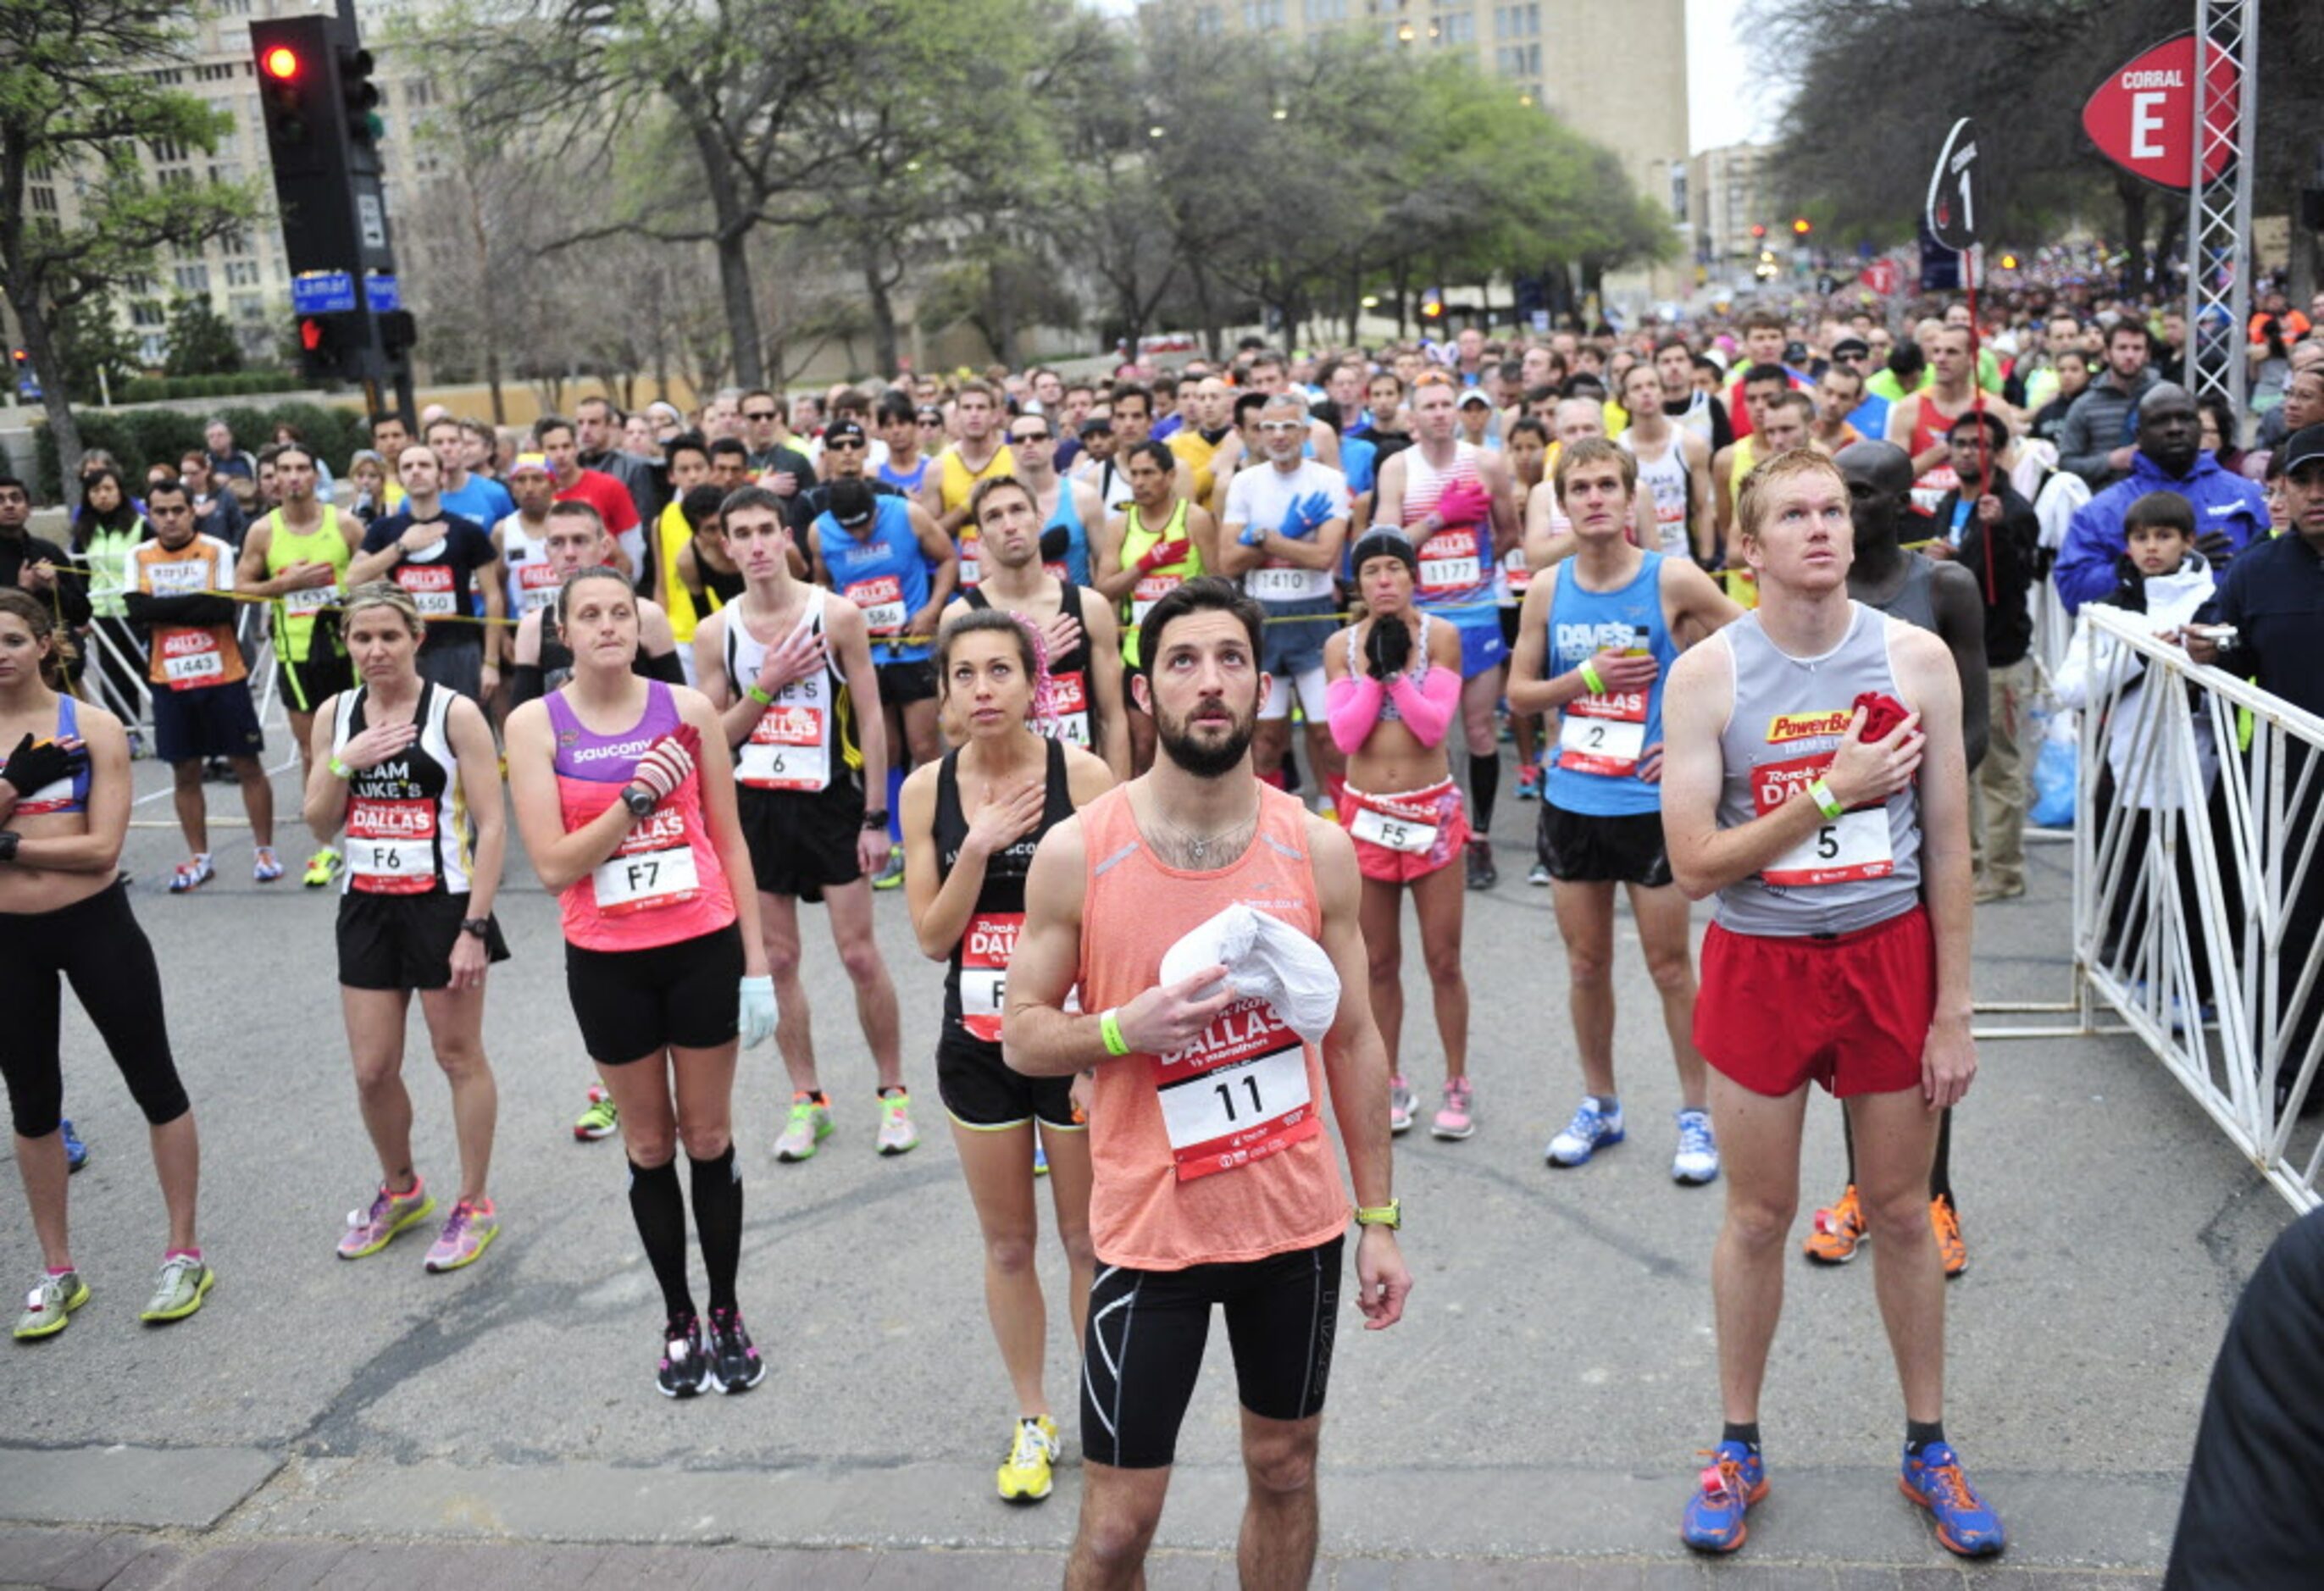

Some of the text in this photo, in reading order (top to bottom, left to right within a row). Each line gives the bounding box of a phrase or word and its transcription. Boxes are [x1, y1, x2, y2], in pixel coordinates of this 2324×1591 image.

[2122, 69, 2185, 90] CORRAL
[2131, 91, 2167, 159] E
[1262, 572, 1303, 589] 1410
[174, 655, 214, 675] 1443
[1589, 725, 1606, 748] 2
[773, 753, 785, 773] 6
[352, 810, 430, 831] DALLAS
[1380, 823, 1408, 846] F5
[1816, 825, 1839, 859] 5
[373, 847, 402, 870] F6
[627, 862, 660, 891] F7
[1214, 1074, 1262, 1123] 11
